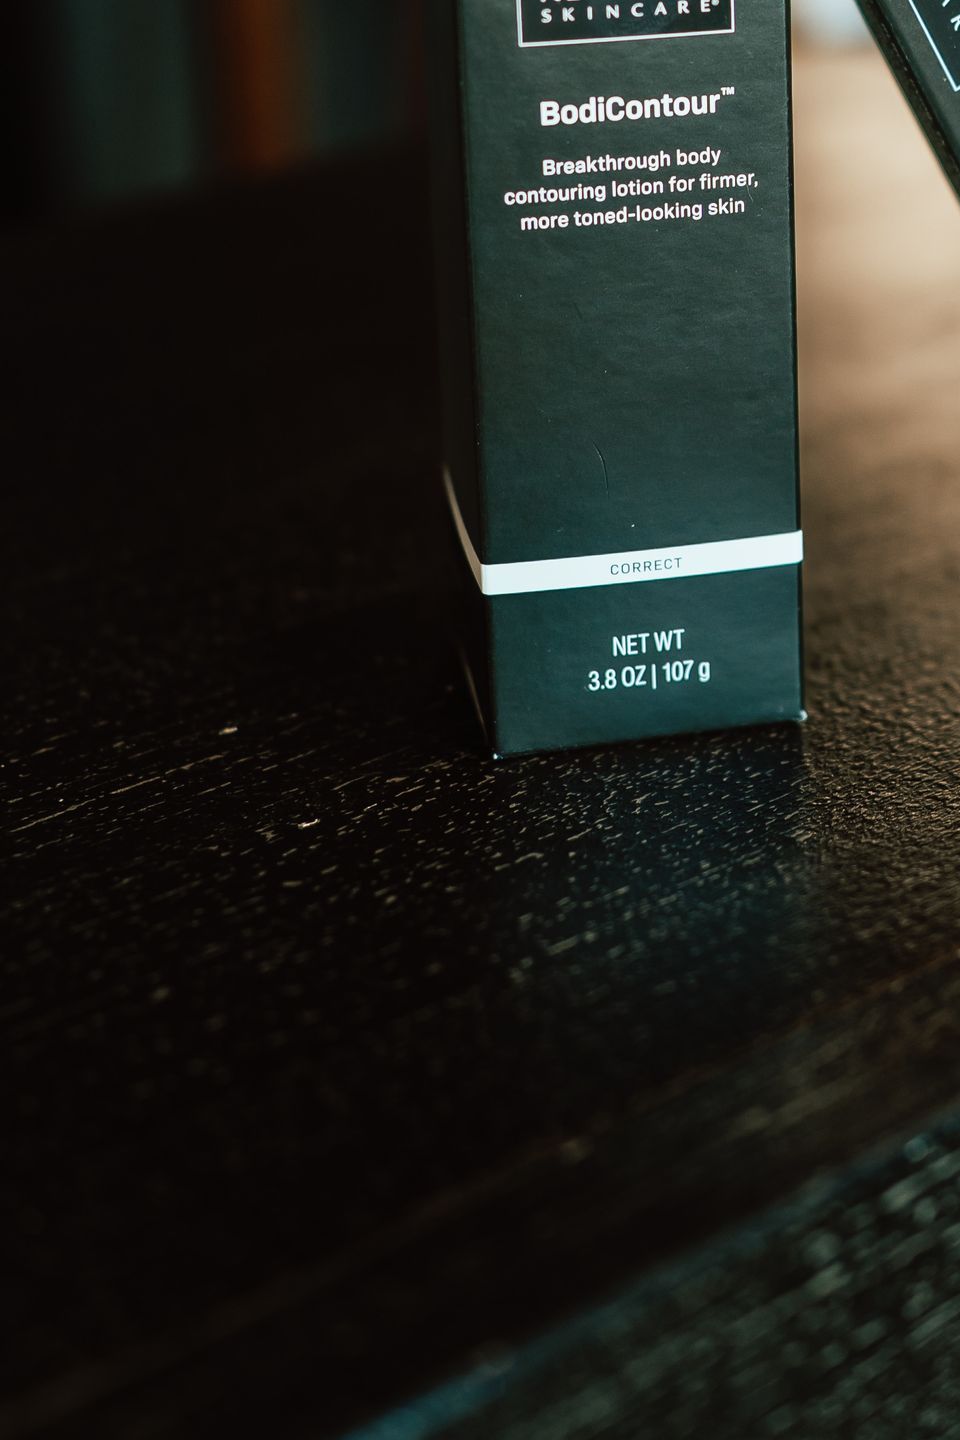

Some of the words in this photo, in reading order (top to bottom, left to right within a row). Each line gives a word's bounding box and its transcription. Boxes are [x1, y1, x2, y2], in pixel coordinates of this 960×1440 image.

[542, 150, 671, 176] Breakthrough
[676, 146, 722, 166] body
[503, 183, 607, 206] contouring
[611, 178, 664, 198] lotion
[668, 175, 695, 193] for
[699, 171, 759, 191] firmer,
[520, 213, 569, 231] more
[573, 202, 703, 228] toned-looking
[708, 197, 745, 217] skin
[610, 556, 683, 576] CORRECT
[612, 632, 650, 657] NET
[653, 628, 685, 652] WT
[587, 668, 617, 692] 3.8
[620, 665, 647, 688] OZ
[662, 659, 694, 682] 107
[698, 661, 711, 683] g
